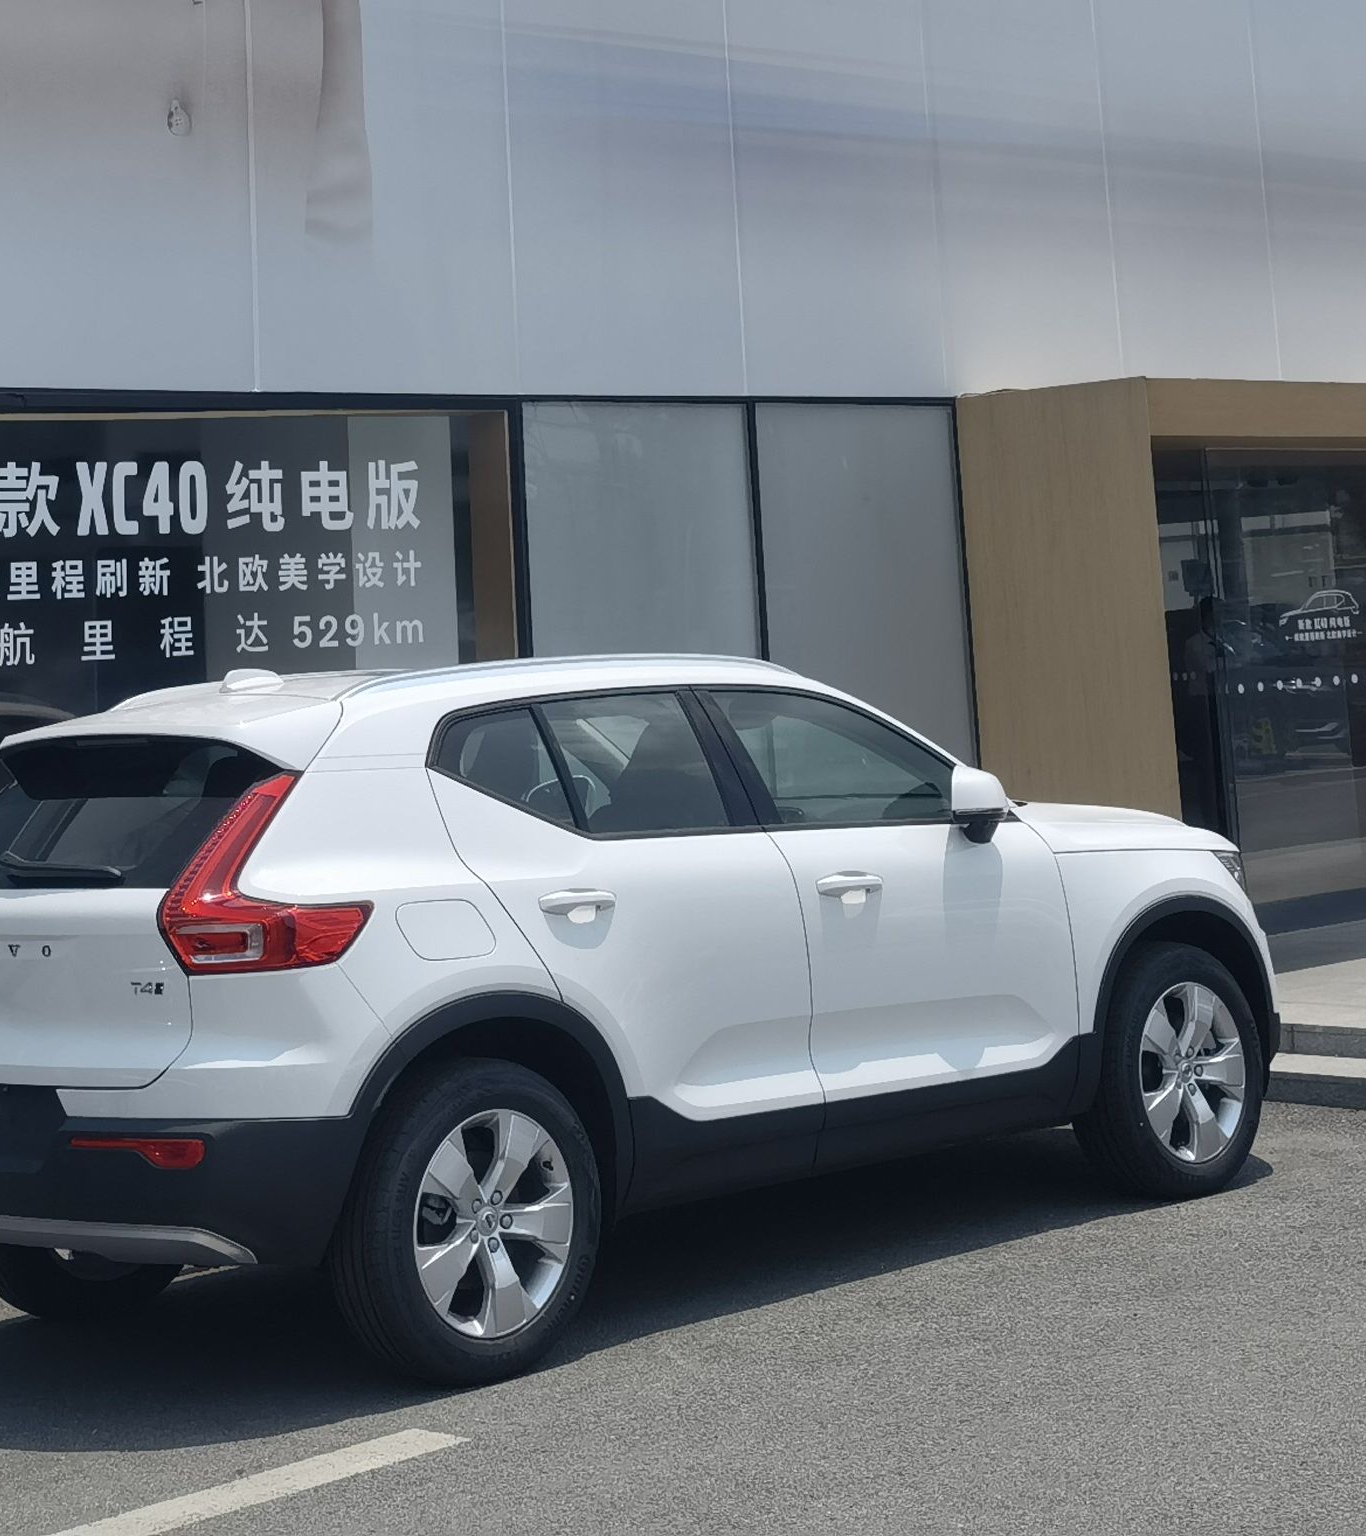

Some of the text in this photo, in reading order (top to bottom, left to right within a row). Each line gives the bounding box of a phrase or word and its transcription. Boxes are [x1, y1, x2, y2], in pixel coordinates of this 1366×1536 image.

[197, 551, 423, 594] 北欧美学设计
